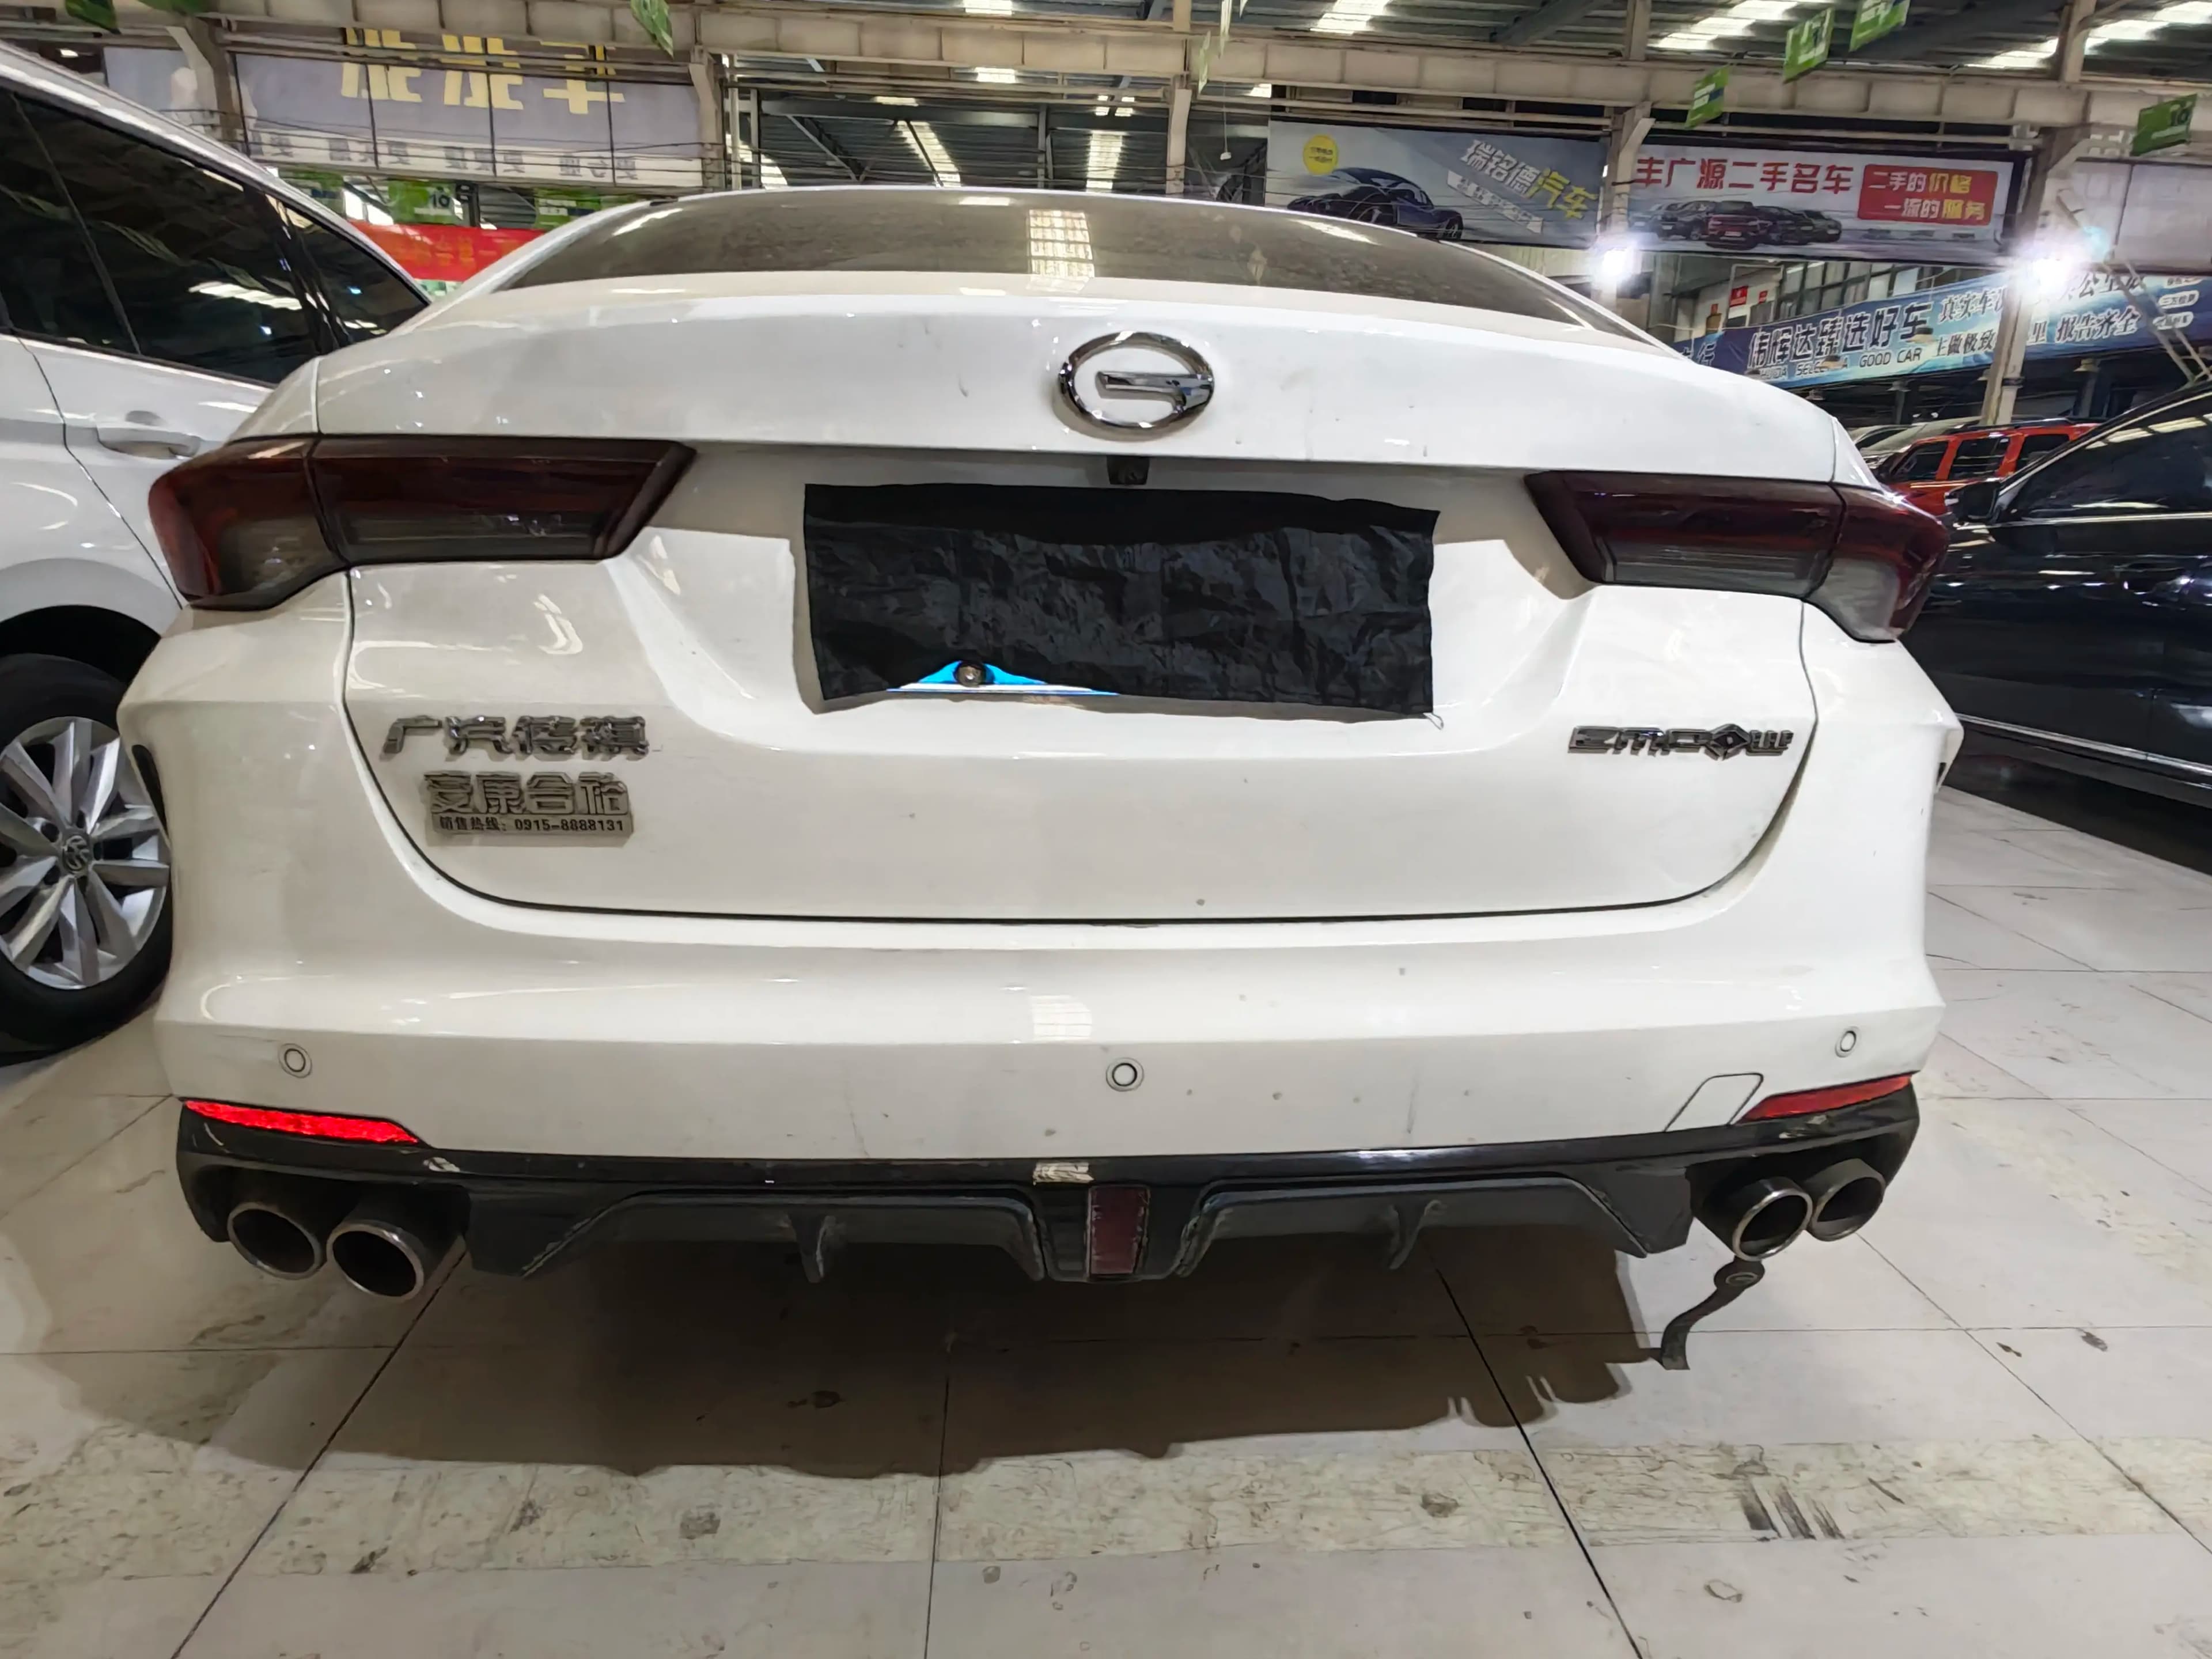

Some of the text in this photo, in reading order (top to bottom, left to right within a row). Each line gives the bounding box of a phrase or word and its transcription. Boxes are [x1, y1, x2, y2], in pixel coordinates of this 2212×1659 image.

[1635, 157, 1854, 194] 丰广源二手名车
[1869, 171, 1978, 194] 二手的价格
[1859, 353, 1891, 369] GOOD
[1896, 347, 1922, 363] CAR
